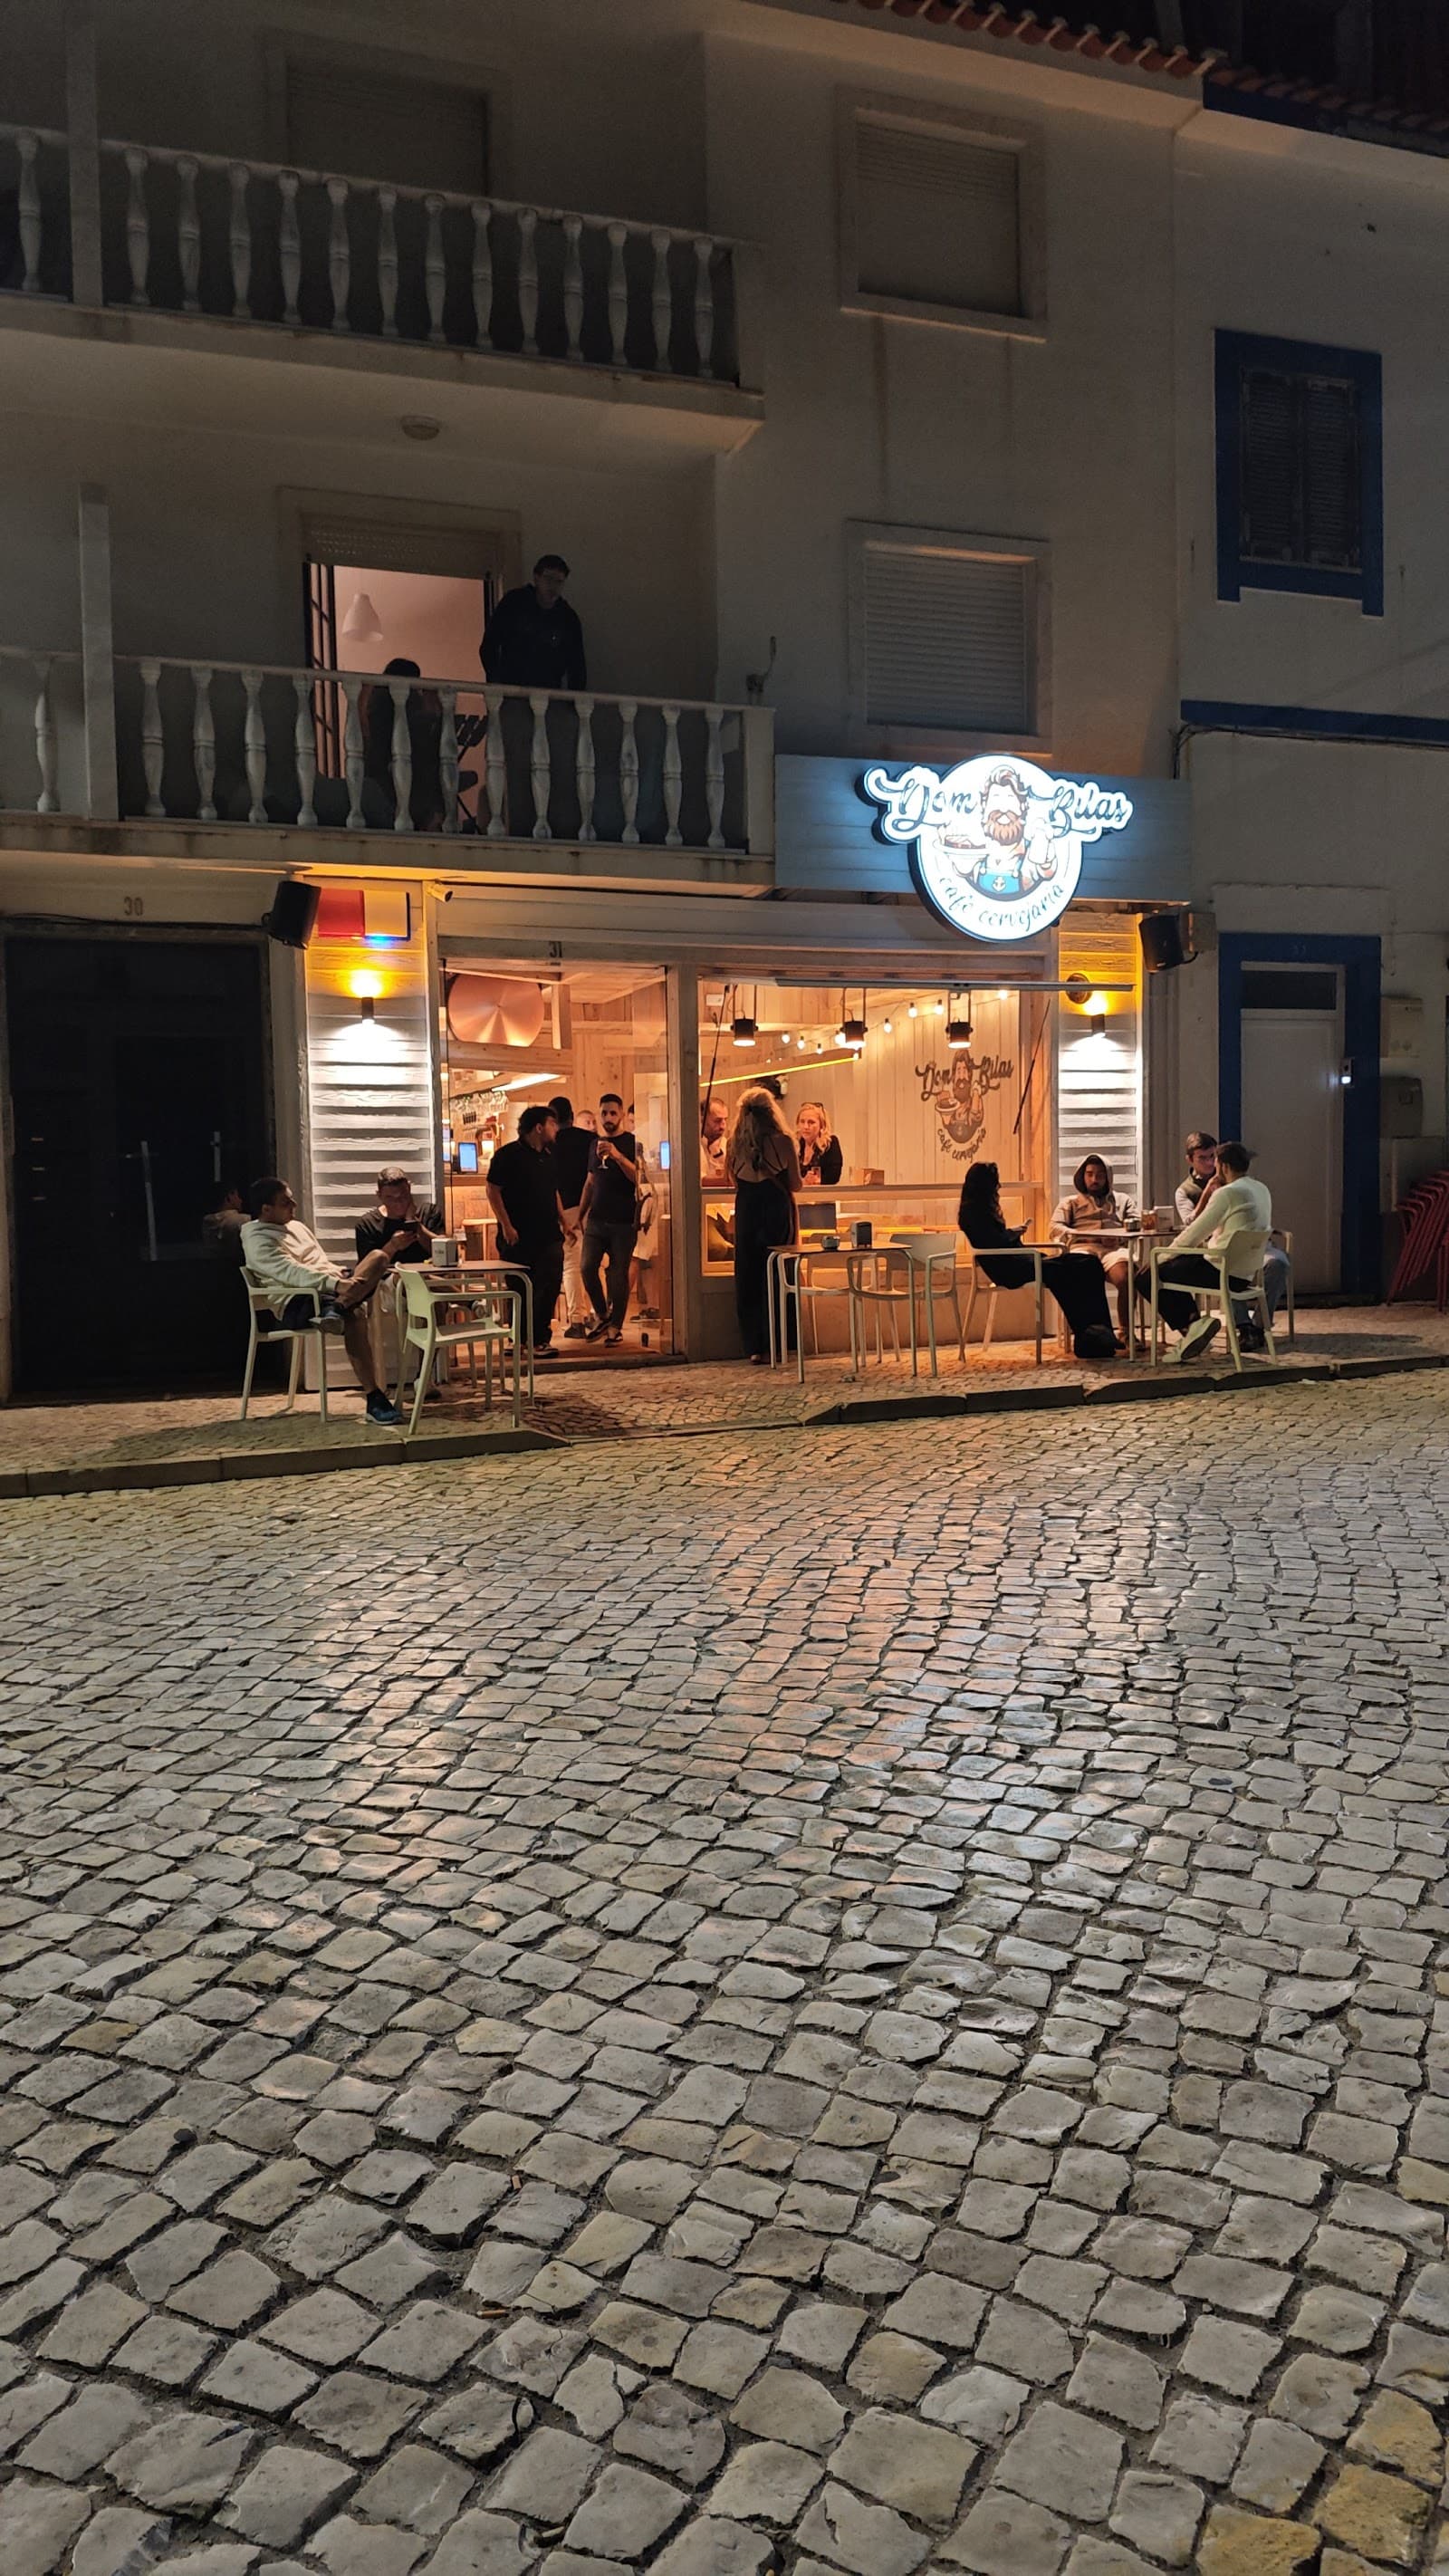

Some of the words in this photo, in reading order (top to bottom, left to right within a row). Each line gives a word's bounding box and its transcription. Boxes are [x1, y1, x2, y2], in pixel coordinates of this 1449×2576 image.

[875, 777, 977, 831] Dom
[124, 897, 143, 916] 30
[979, 884, 1064, 931] cervejaria
[549, 940, 563, 958] 31
[915, 1060, 953, 1101] Dom
[937, 1128, 954, 1153] café
